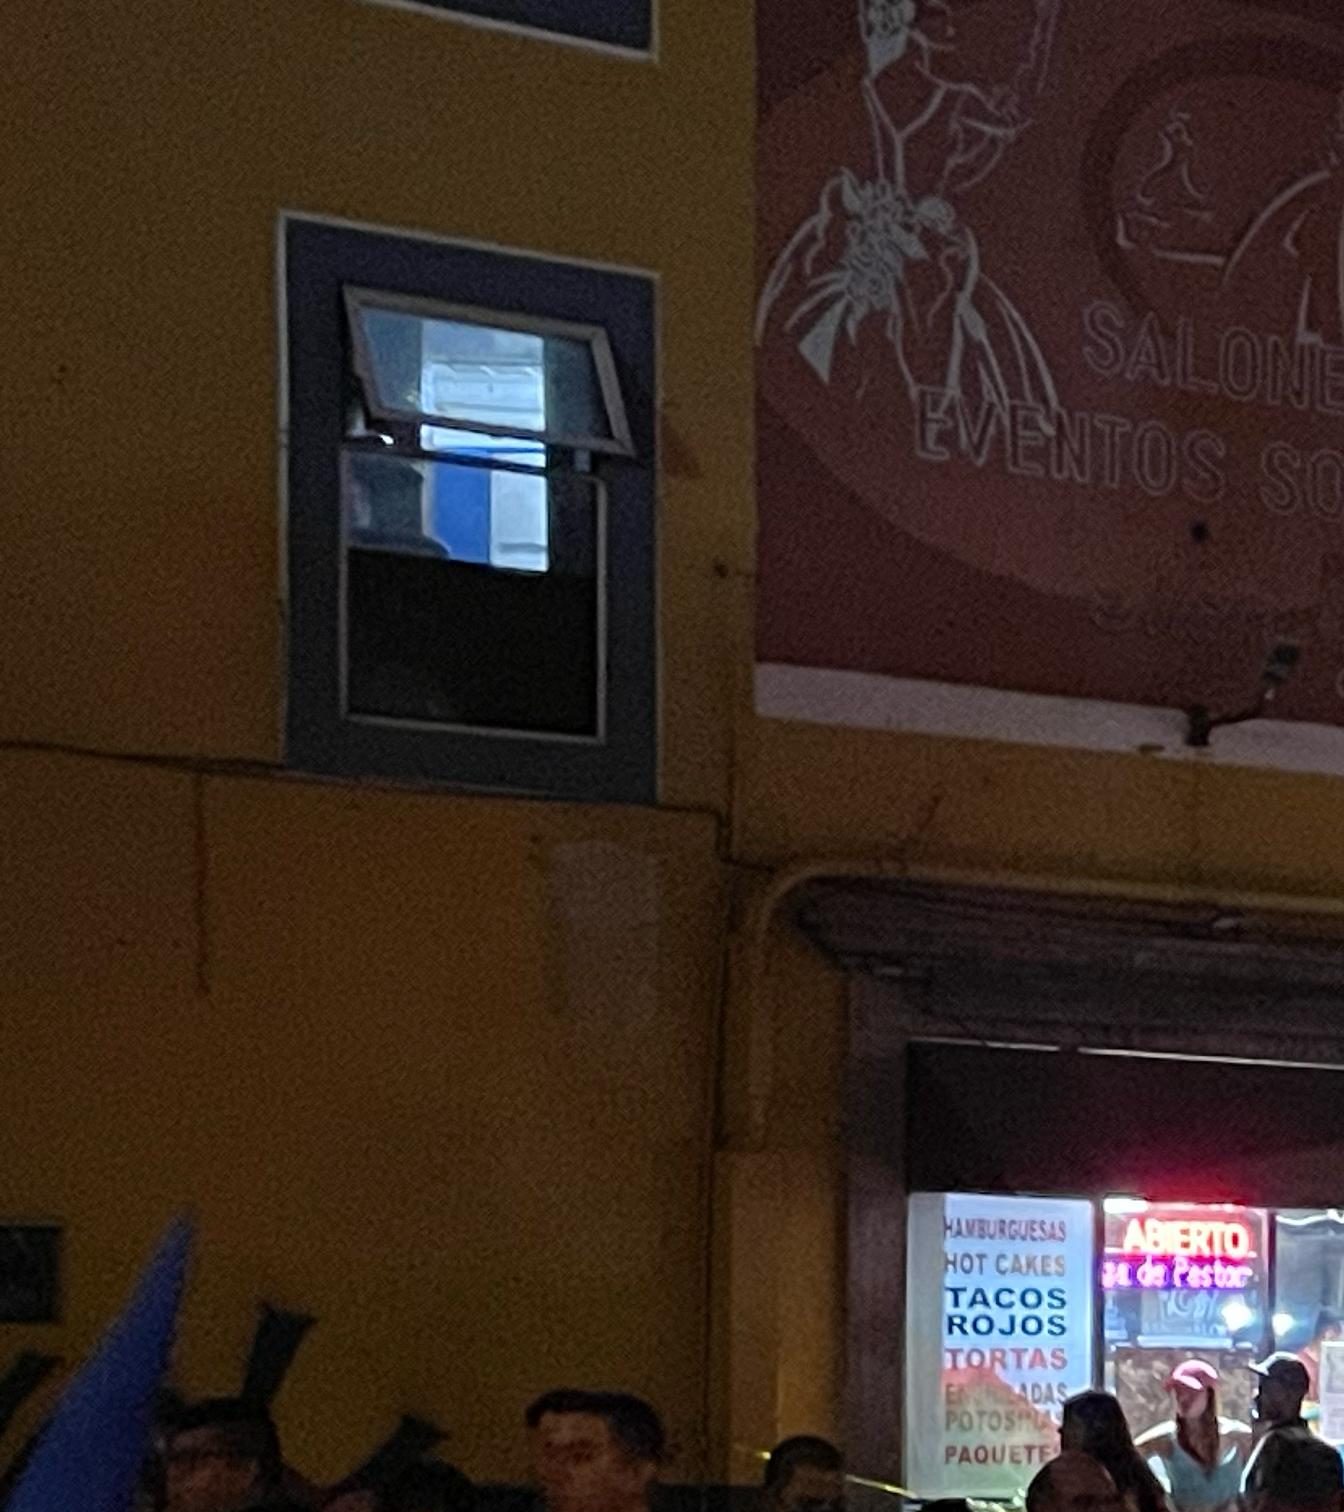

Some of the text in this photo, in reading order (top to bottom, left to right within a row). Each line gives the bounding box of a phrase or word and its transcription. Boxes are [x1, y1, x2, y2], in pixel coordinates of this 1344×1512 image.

[913, 384, 1227, 501] EVENTOS
[943, 1216, 1067, 1243] HAMBURGUESAS
[1123, 1217, 1251, 1259] ABIERTO
[944, 1252, 1066, 1277] HOT CAKES
[944, 1286, 1067, 1310] TACOS
[947, 1314, 1067, 1336] ROJOS
[944, 1347, 1068, 1370] TORTAS
